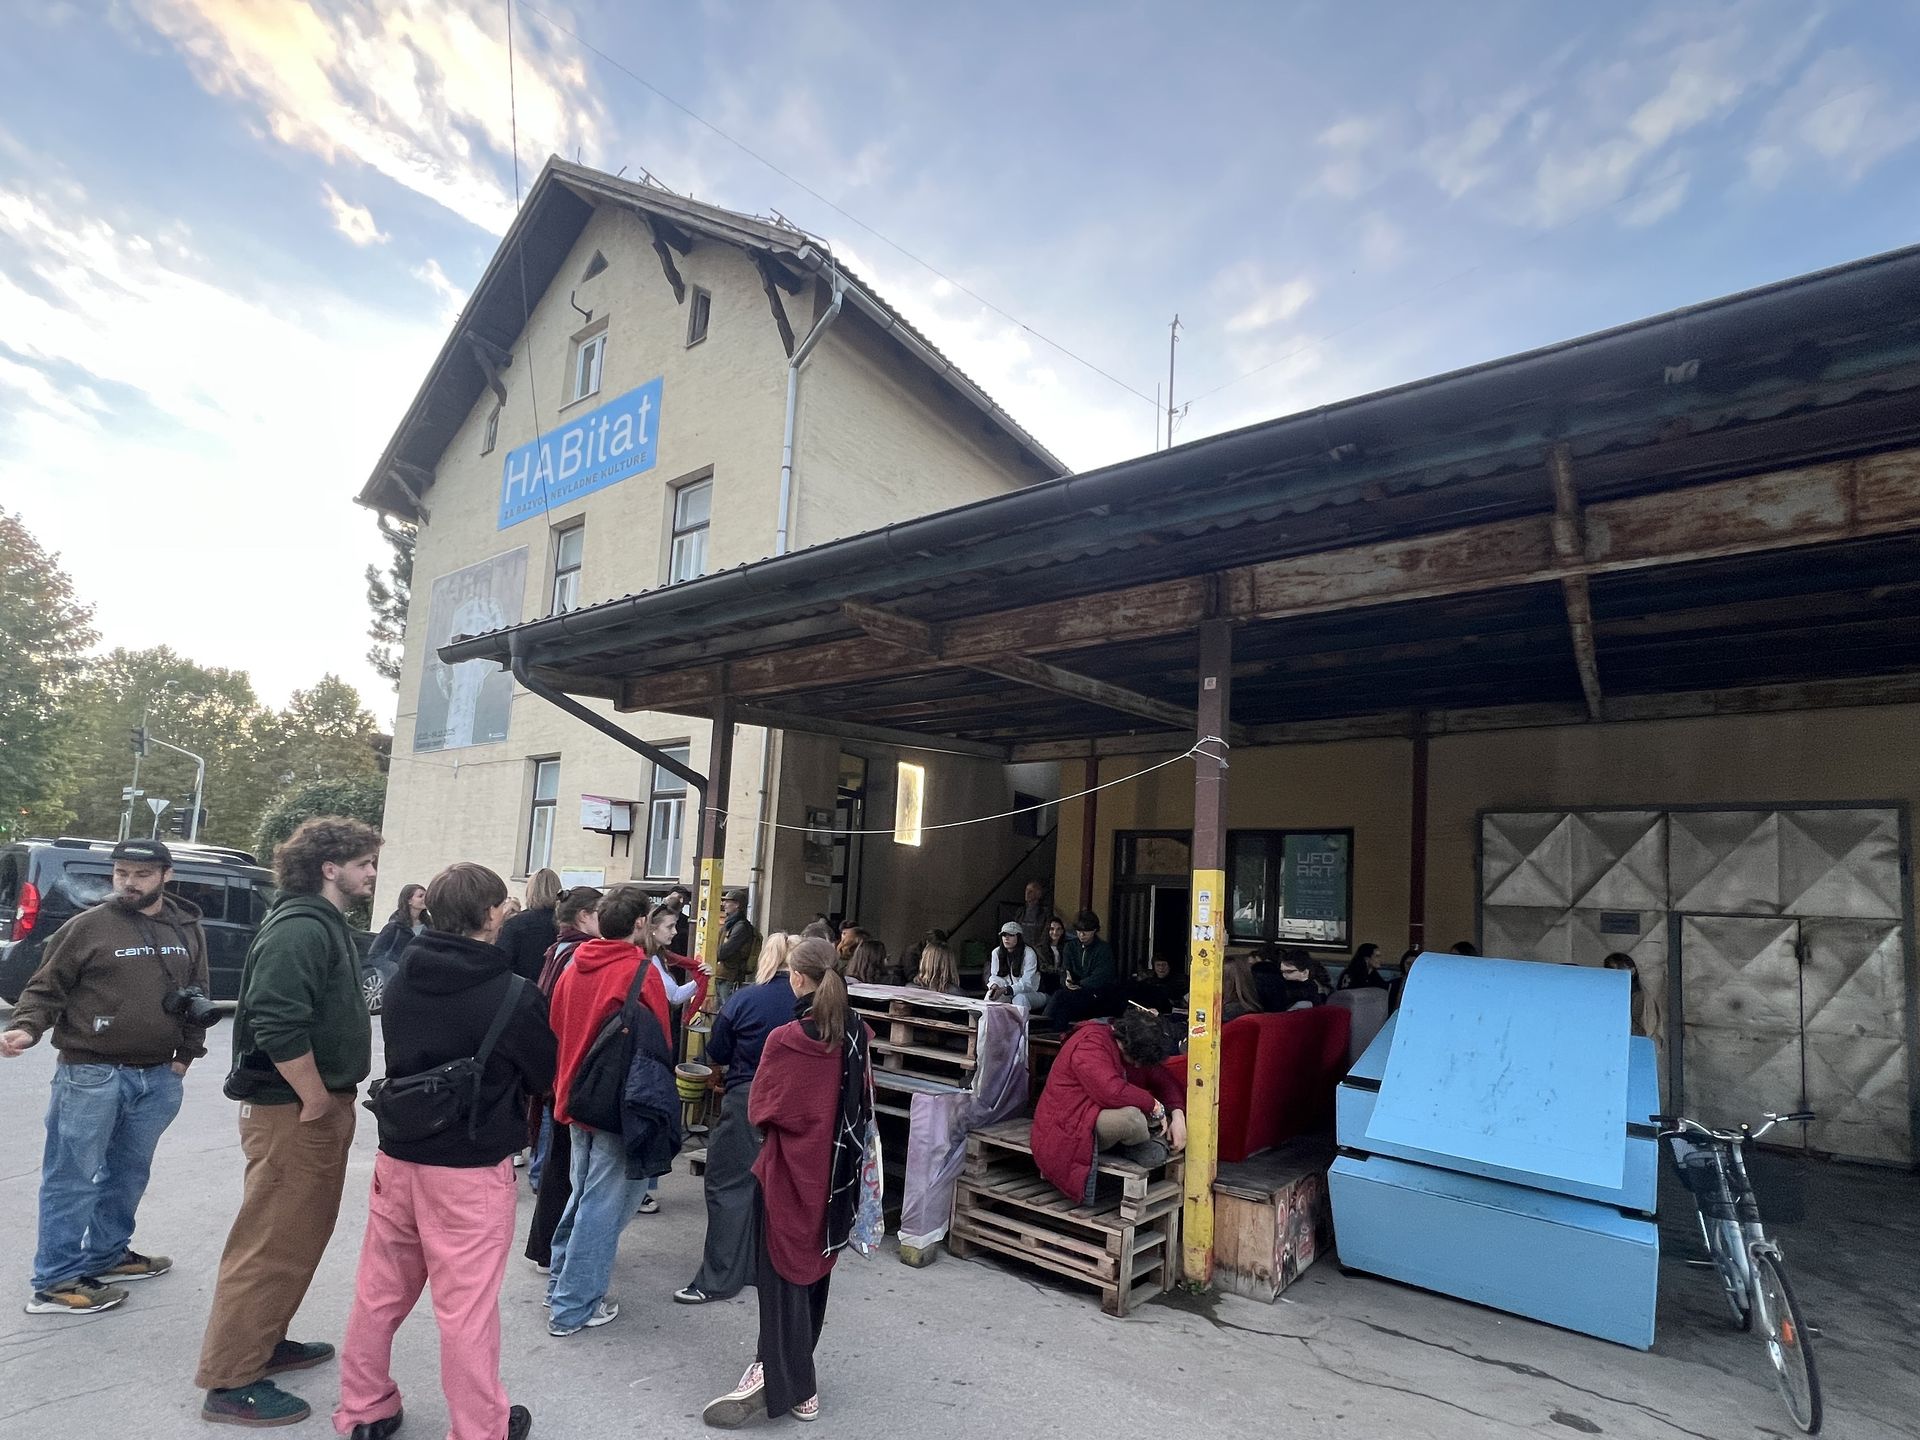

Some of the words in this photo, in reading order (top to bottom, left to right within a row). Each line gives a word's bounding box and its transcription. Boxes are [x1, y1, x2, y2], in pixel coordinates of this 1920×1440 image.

[505, 395, 651, 503] HABitat
[504, 508, 514, 520] ZA
[516, 498, 547, 514] RAZVOJ
[551, 473, 598, 500] NEVLADNE
[601, 451, 647, 478] KULTURE
[1297, 853, 1335, 864] UFO
[1297, 866, 1335, 877] ART
